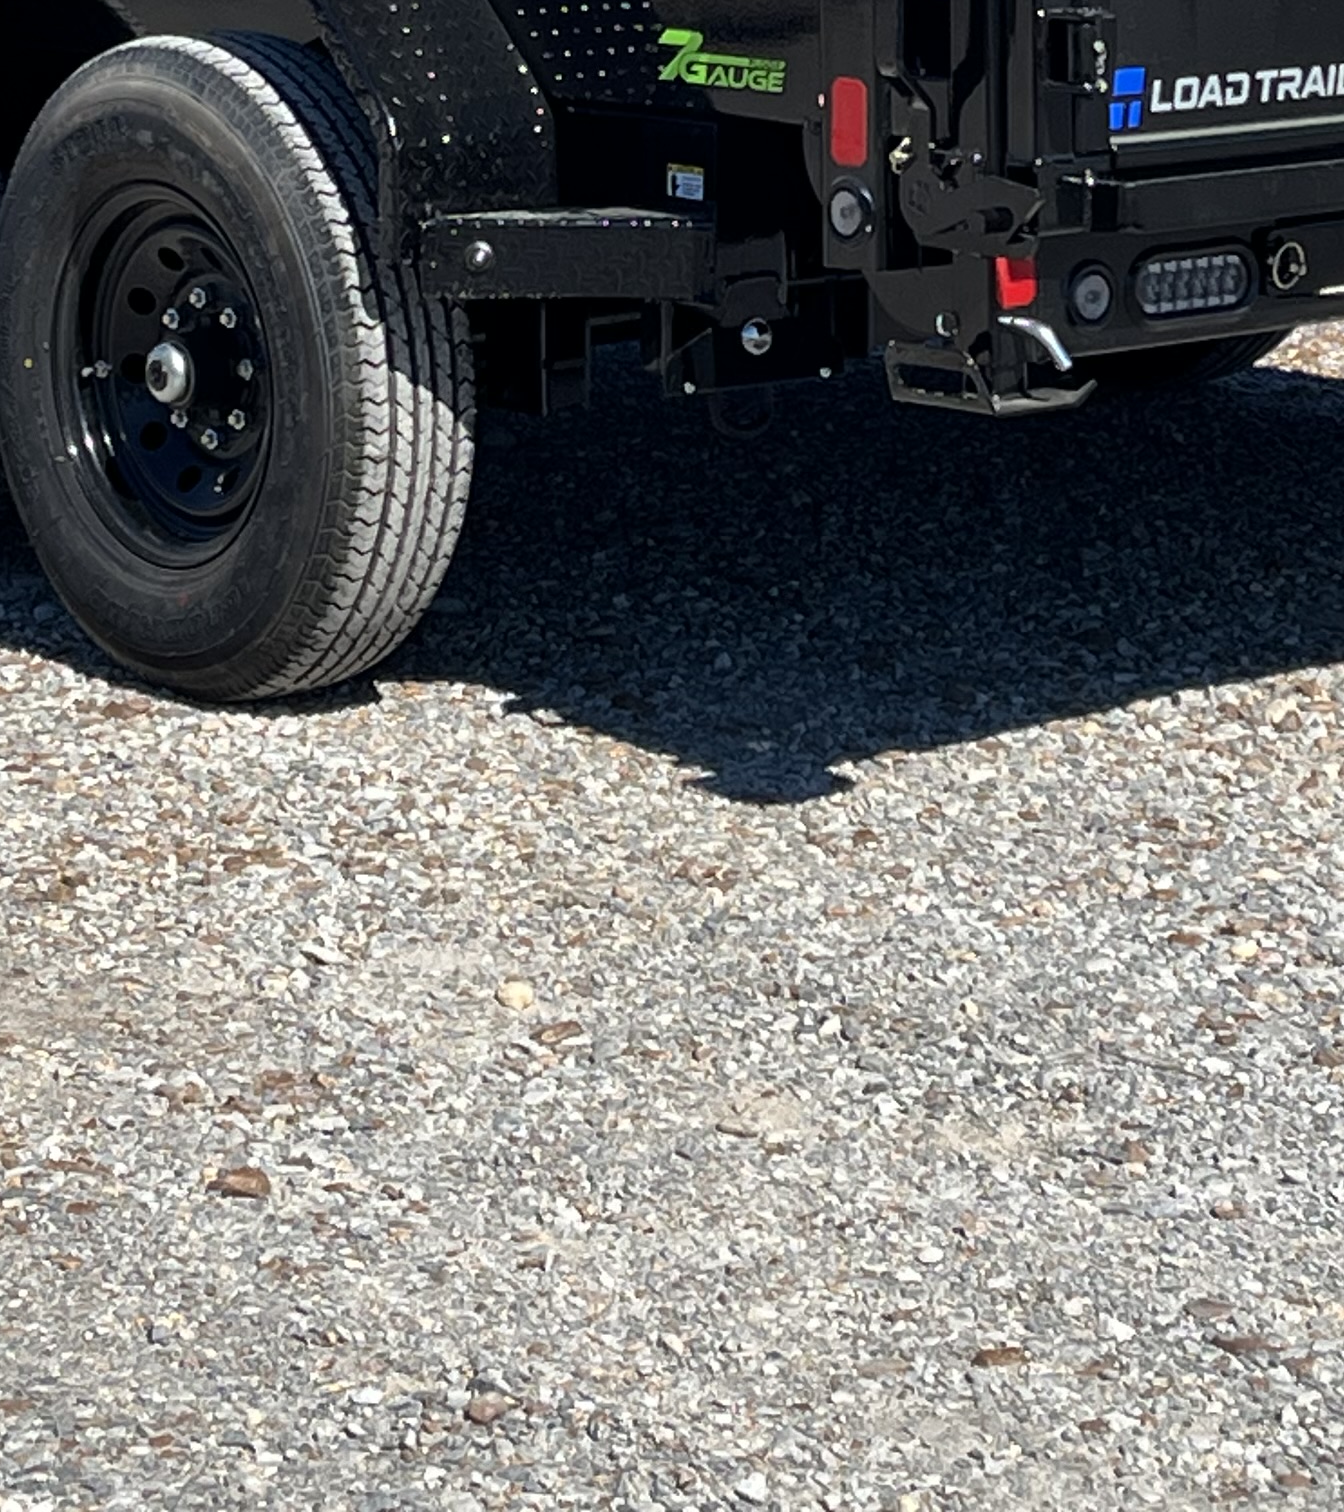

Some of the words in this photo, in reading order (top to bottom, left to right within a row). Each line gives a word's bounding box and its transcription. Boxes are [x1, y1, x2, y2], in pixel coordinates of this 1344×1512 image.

[657, 27, 704, 82] 7
[680, 52, 787, 94] GAUGE
[1149, 72, 1250, 114] LOAD
